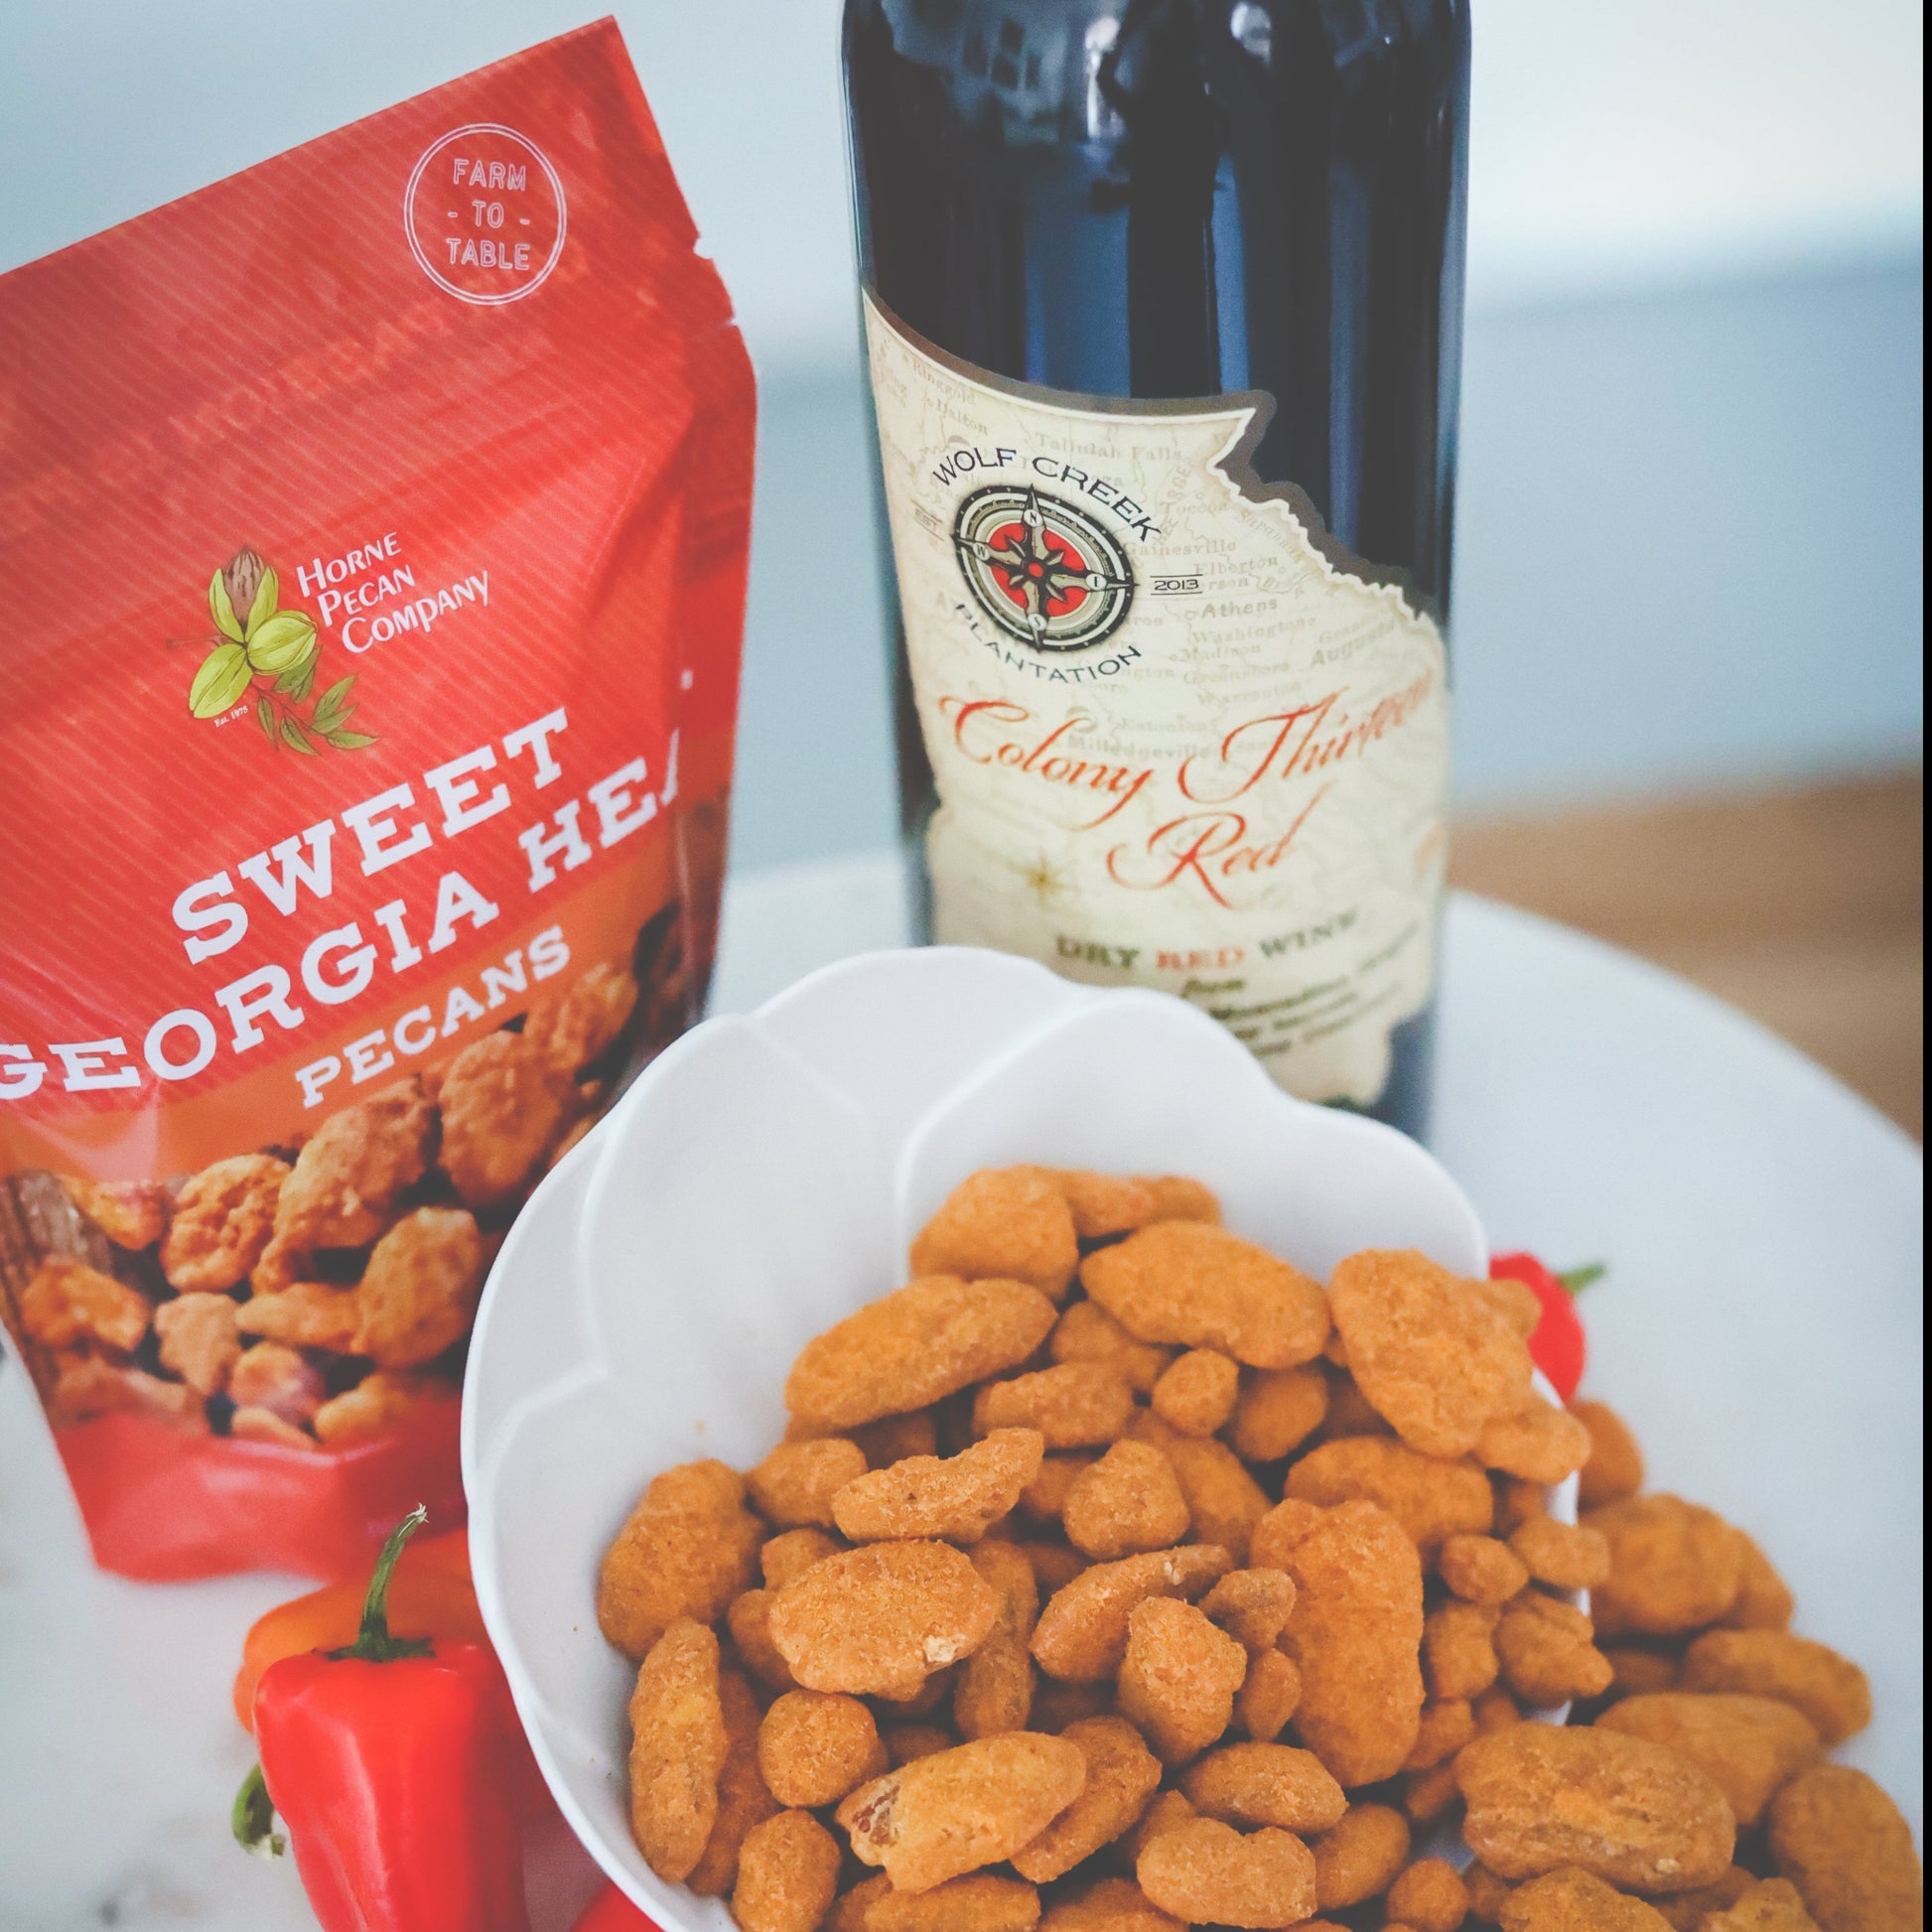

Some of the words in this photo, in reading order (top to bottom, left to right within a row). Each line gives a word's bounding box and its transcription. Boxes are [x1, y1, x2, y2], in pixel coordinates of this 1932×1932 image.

[453, 158, 527, 192] FARM
[446, 237, 530, 271] TABLE
[931, 447, 1018, 487] WOLF
[1031, 455, 1163, 544] CREEK
[296, 530, 402, 598] HORNE
[317, 564, 416, 627] PECAN
[1153, 578, 1200, 593] 2013
[342, 570, 489, 654] COMPANY
[954, 603, 1144, 684] PLANTATION
[1200, 599, 1278, 621] Athens
[939, 695, 1155, 832] Colony
[171, 706, 570, 966] SWEET
[1106, 781, 1335, 911] Red
[0, 871, 500, 1101] GEORGIA
[295, 924, 572, 1110] PECANS
